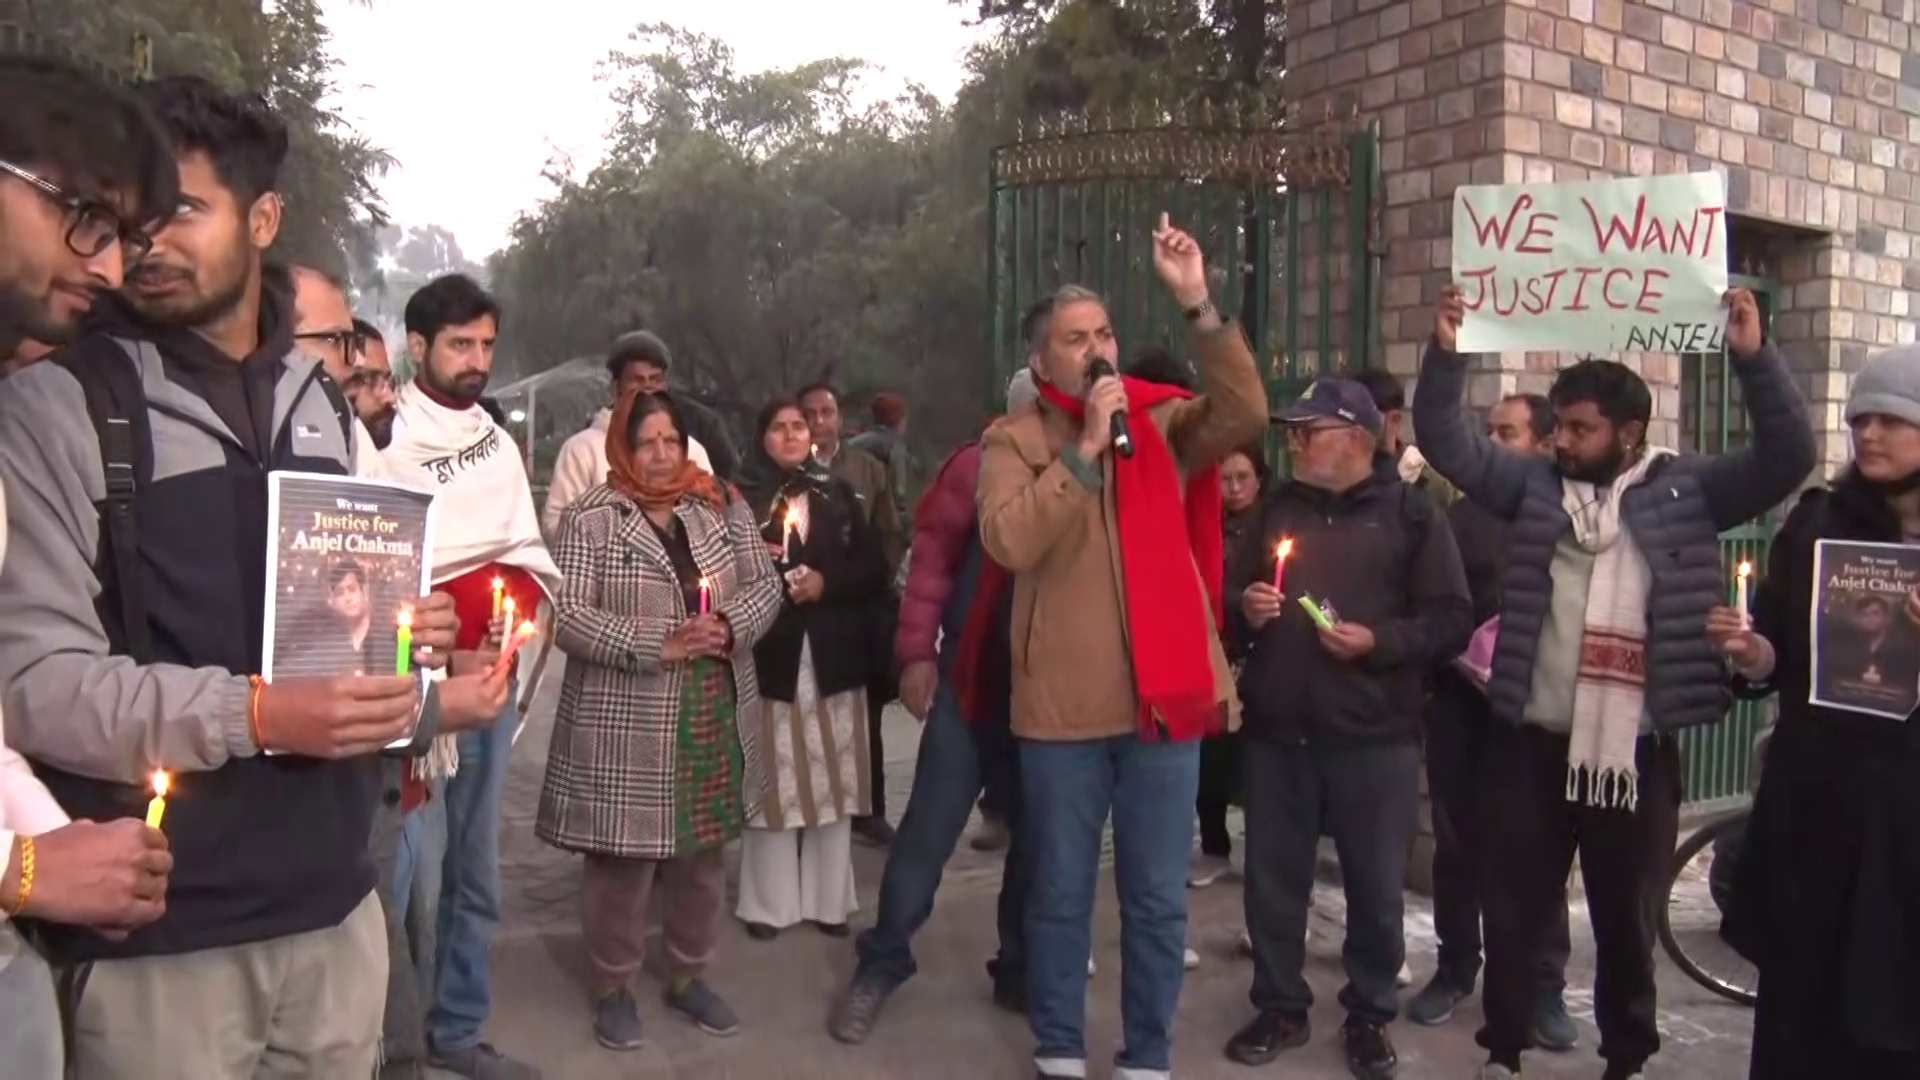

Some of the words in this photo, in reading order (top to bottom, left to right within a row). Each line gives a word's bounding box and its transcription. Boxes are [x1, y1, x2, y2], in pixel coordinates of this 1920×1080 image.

[1462, 194, 1559, 254] WE
[1581, 194, 1723, 258] WANT
[1460, 266, 1670, 316] JUSTICE
[1625, 323, 1720, 352] ANJEL
[336, 498, 353, 511] We
[354, 502, 379, 513] want
[312, 511, 370, 532] Justice
[373, 516, 398, 535] for
[290, 530, 343, 555] Anjel
[344, 533, 414, 557] Chakma
[1843, 562, 1891, 578] Justice
[1827, 574, 1867, 592] Anjel
